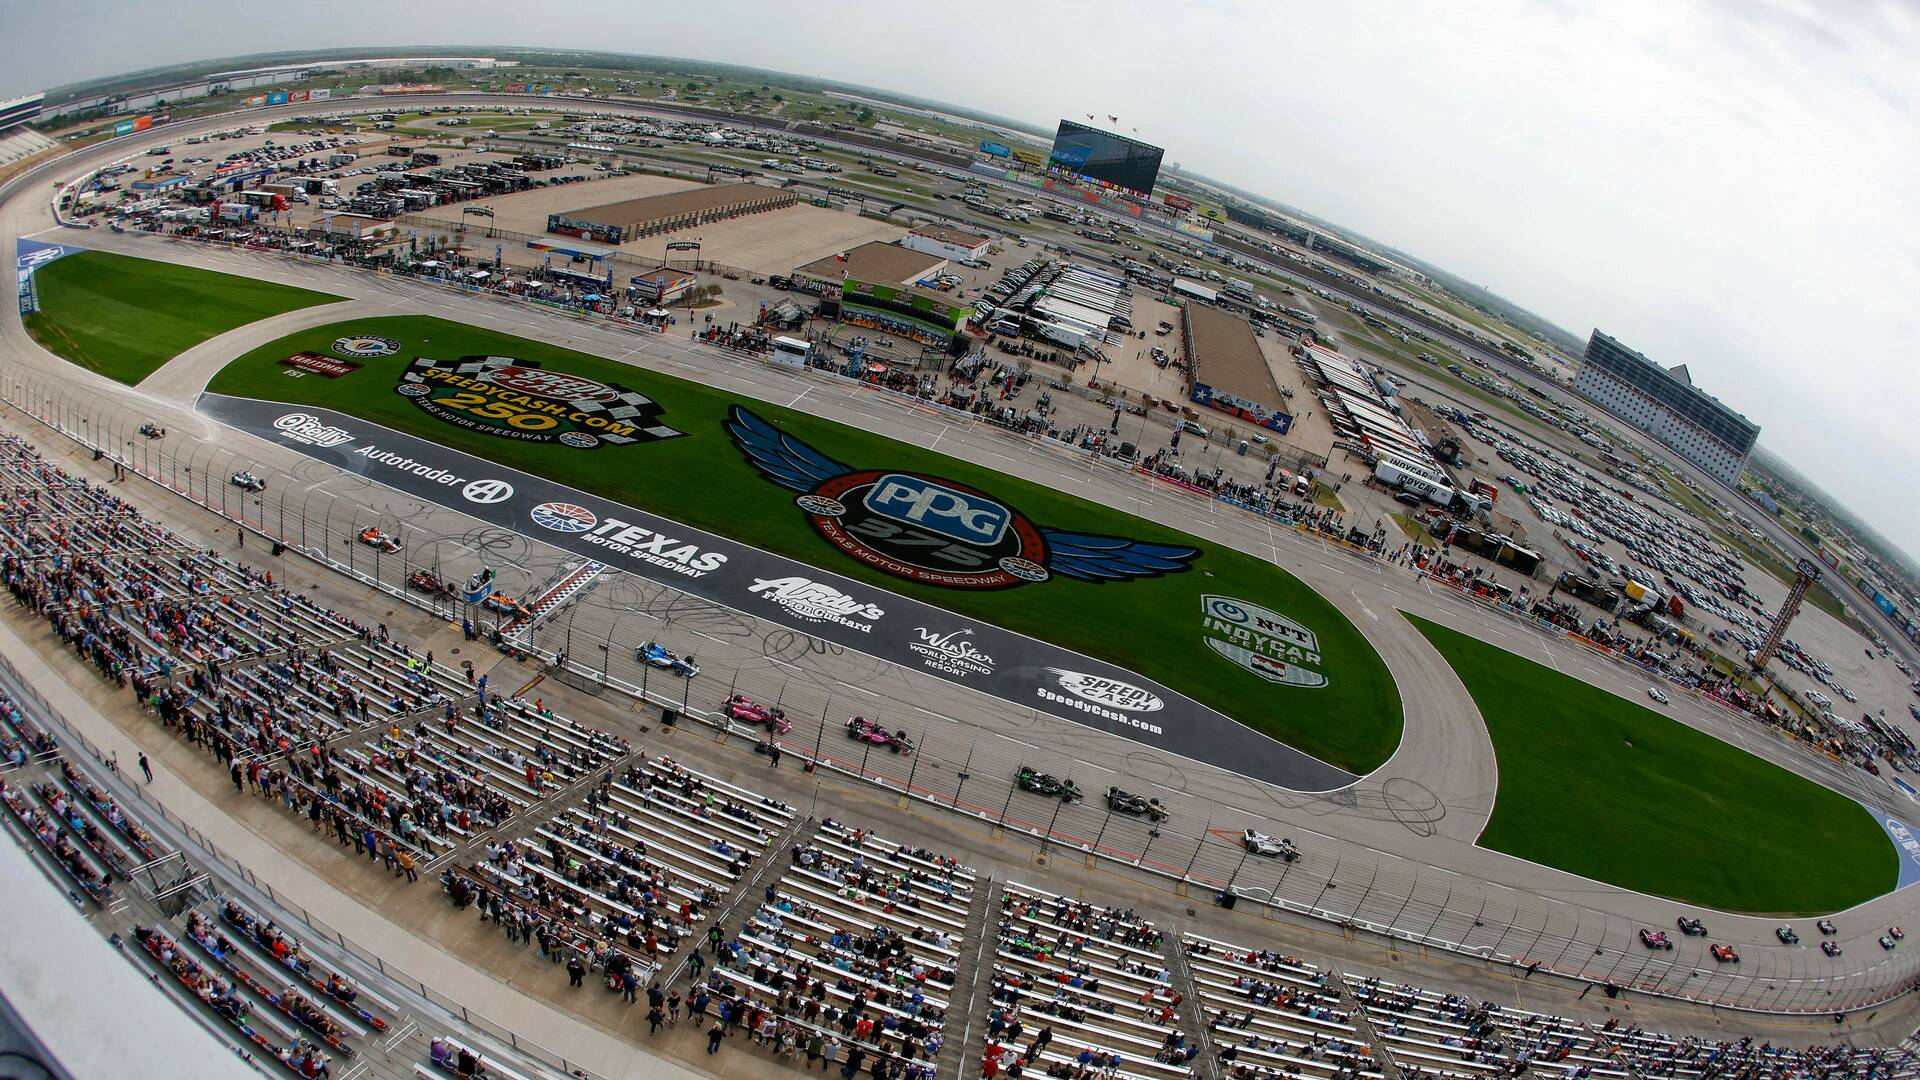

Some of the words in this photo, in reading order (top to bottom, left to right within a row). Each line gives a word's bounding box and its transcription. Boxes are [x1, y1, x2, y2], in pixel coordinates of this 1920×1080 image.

[1068, 122, 1090, 132] TEXAS
[1091, 127, 1117, 139] MOTOR
[1118, 135, 1158, 151] SPEEDWAY
[289, 355, 350, 374] CRAFTSMAN
[515, 369, 612, 396] SPEEDY
[415, 396, 442, 412] TEXAS
[438, 410, 475, 428] MOTOR
[476, 424, 552, 442] SPEEDWAY
[420, 368, 637, 437] SPEEDYCASH.COM
[432, 392, 558, 430] 250
[273, 412, 356, 448] O'Reilly
[353, 445, 466, 487] Autotrader
[1389, 458, 1430, 481] INDYCAR
[876, 482, 1001, 537] PPG
[580, 533, 631, 554] MOTOR
[629, 548, 707, 579] SPEEDWAY
[592, 518, 729, 571] TEXAS
[820, 520, 854, 549] TEXAS
[854, 549, 914, 576] MOTOR
[919, 570, 1006, 586] SPEEDWAY
[845, 517, 993, 567] 375
[748, 577, 885, 620] Andy's
[762, 591, 815, 617] Frozen
[813, 608, 873, 634] Custard
[913, 627, 996, 666] WinStar
[1202, 617, 1321, 666] INDYCAR
[1228, 635, 1298, 664] SERIES
[1255, 616, 1308, 643] NTT
[910, 643, 948, 661] WORLD
[950, 657, 992, 676] CASINO
[924, 659, 968, 678] RESORT
[1079, 676, 1156, 703] SPEEDY
[1036, 687, 1163, 736] SpeedyCash.com
